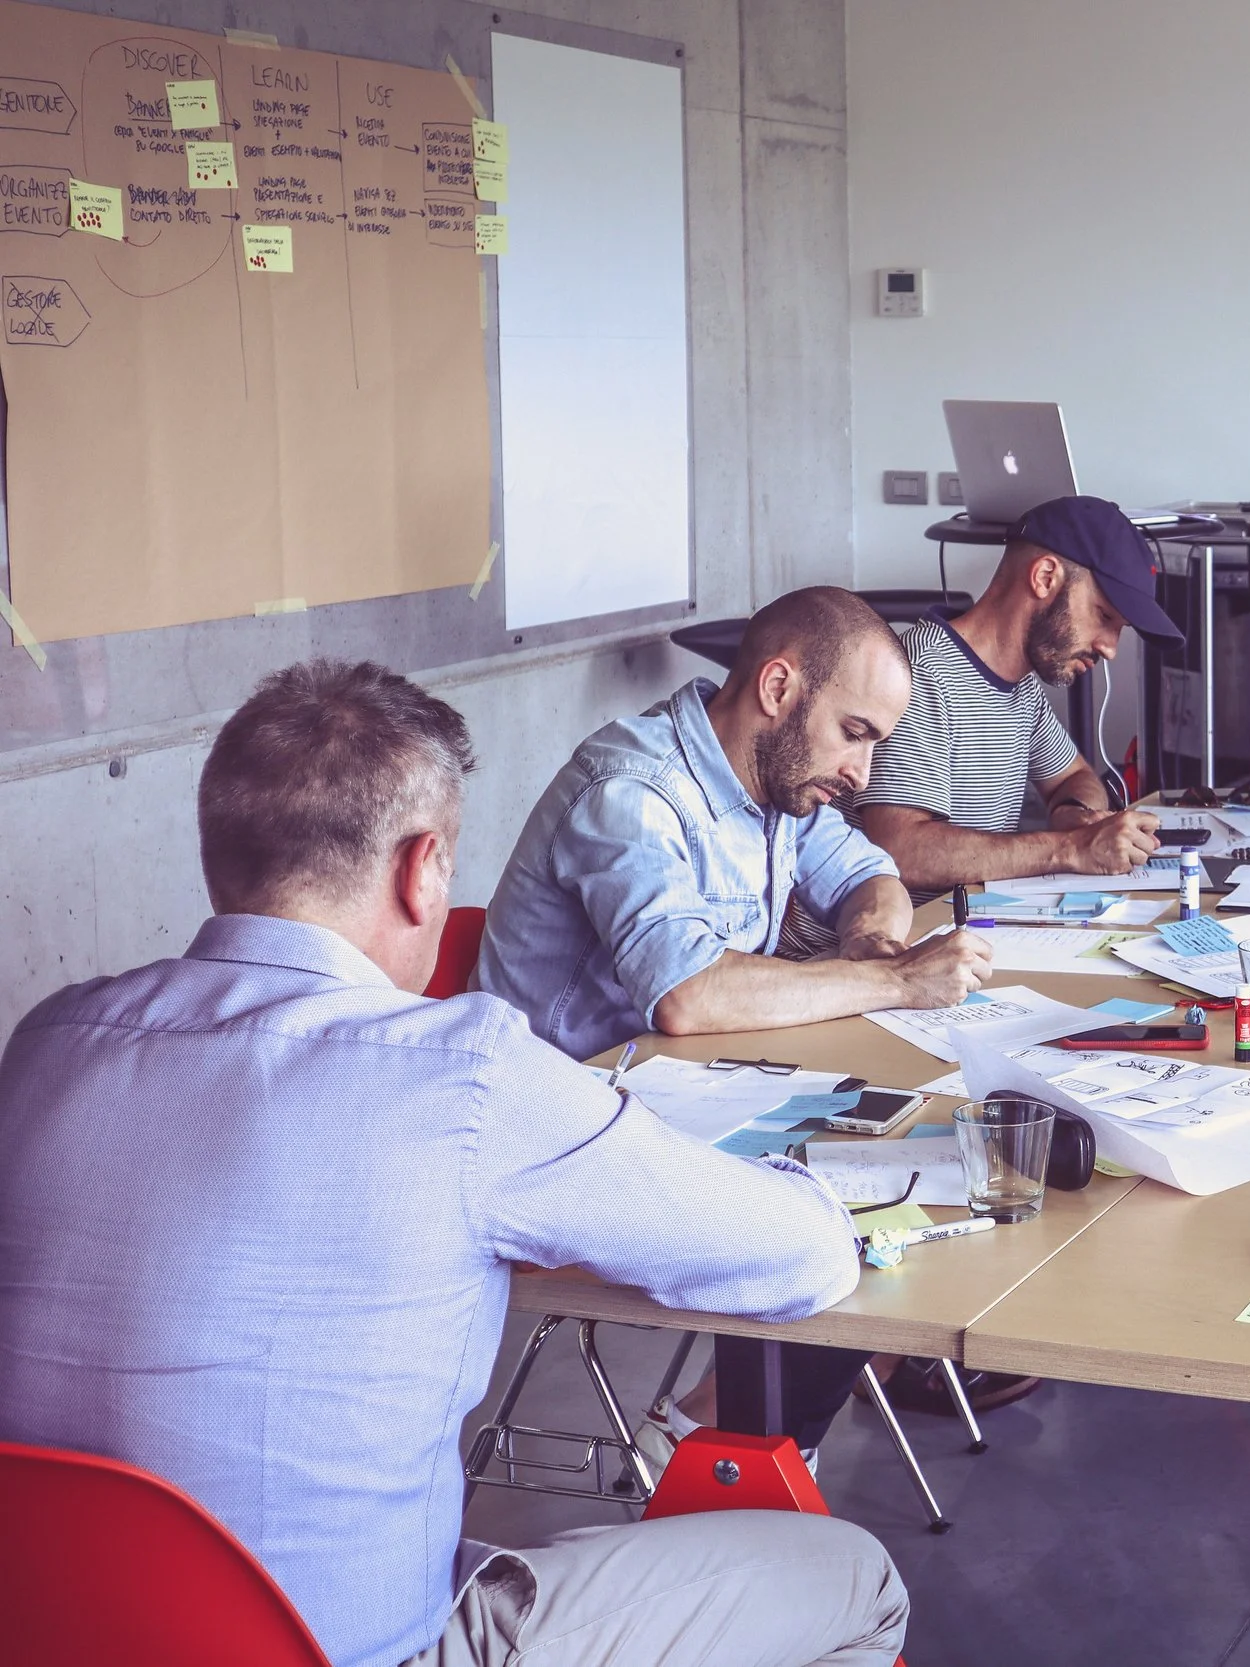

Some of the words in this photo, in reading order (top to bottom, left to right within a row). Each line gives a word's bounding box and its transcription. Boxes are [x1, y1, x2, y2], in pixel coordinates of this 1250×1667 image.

[122, 45, 203, 80] DISCOVER
[252, 64, 310, 92] LEARN
[366, 82, 395, 108] USE
[150, 141, 185, 155] GOOGLE
[4, 202, 63, 224] EVENTO
